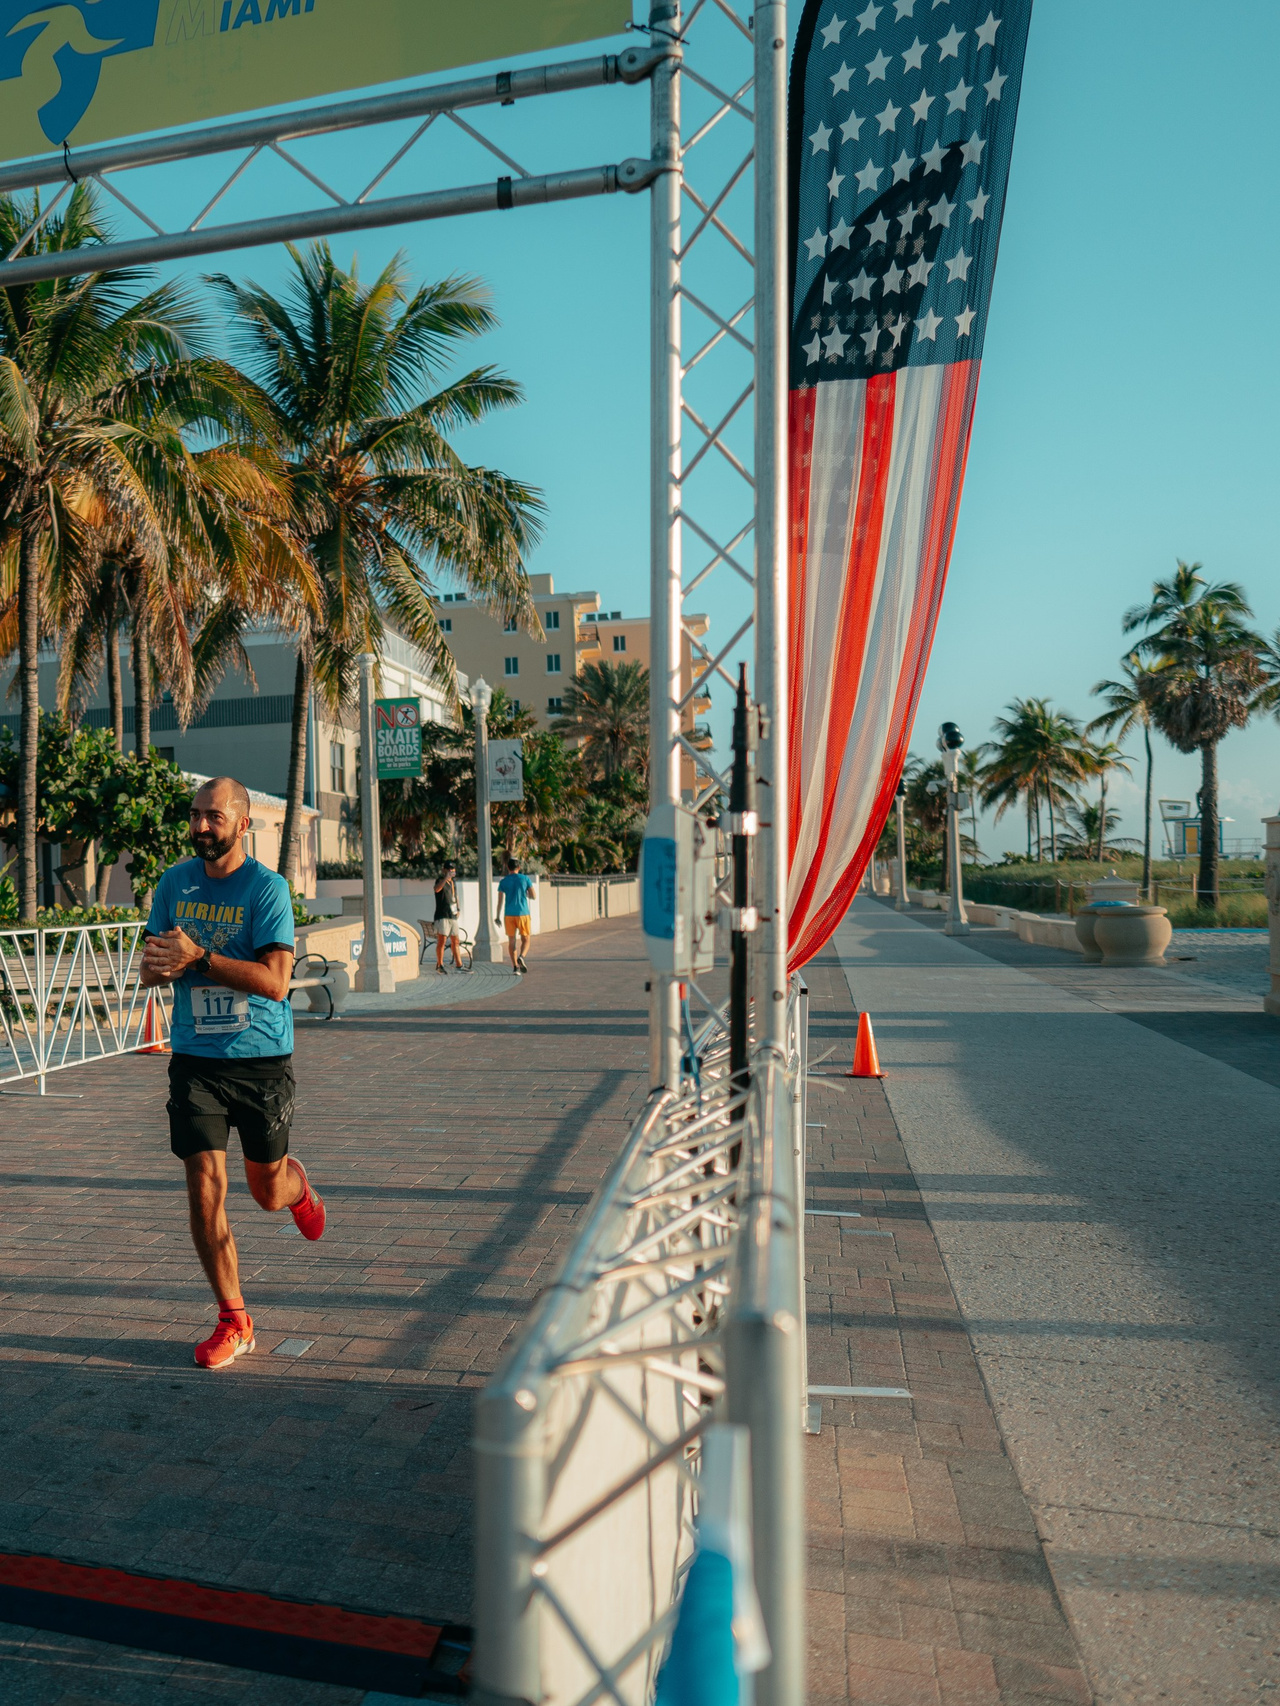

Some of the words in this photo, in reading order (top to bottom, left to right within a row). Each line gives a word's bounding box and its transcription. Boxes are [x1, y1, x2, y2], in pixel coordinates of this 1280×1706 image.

[377, 728, 419, 746] SKATE
[378, 744, 419, 758] BOARDS
[175, 901, 245, 924] UKRAINE
[393, 941, 407, 952] PARK
[204, 996, 234, 1015] 117
